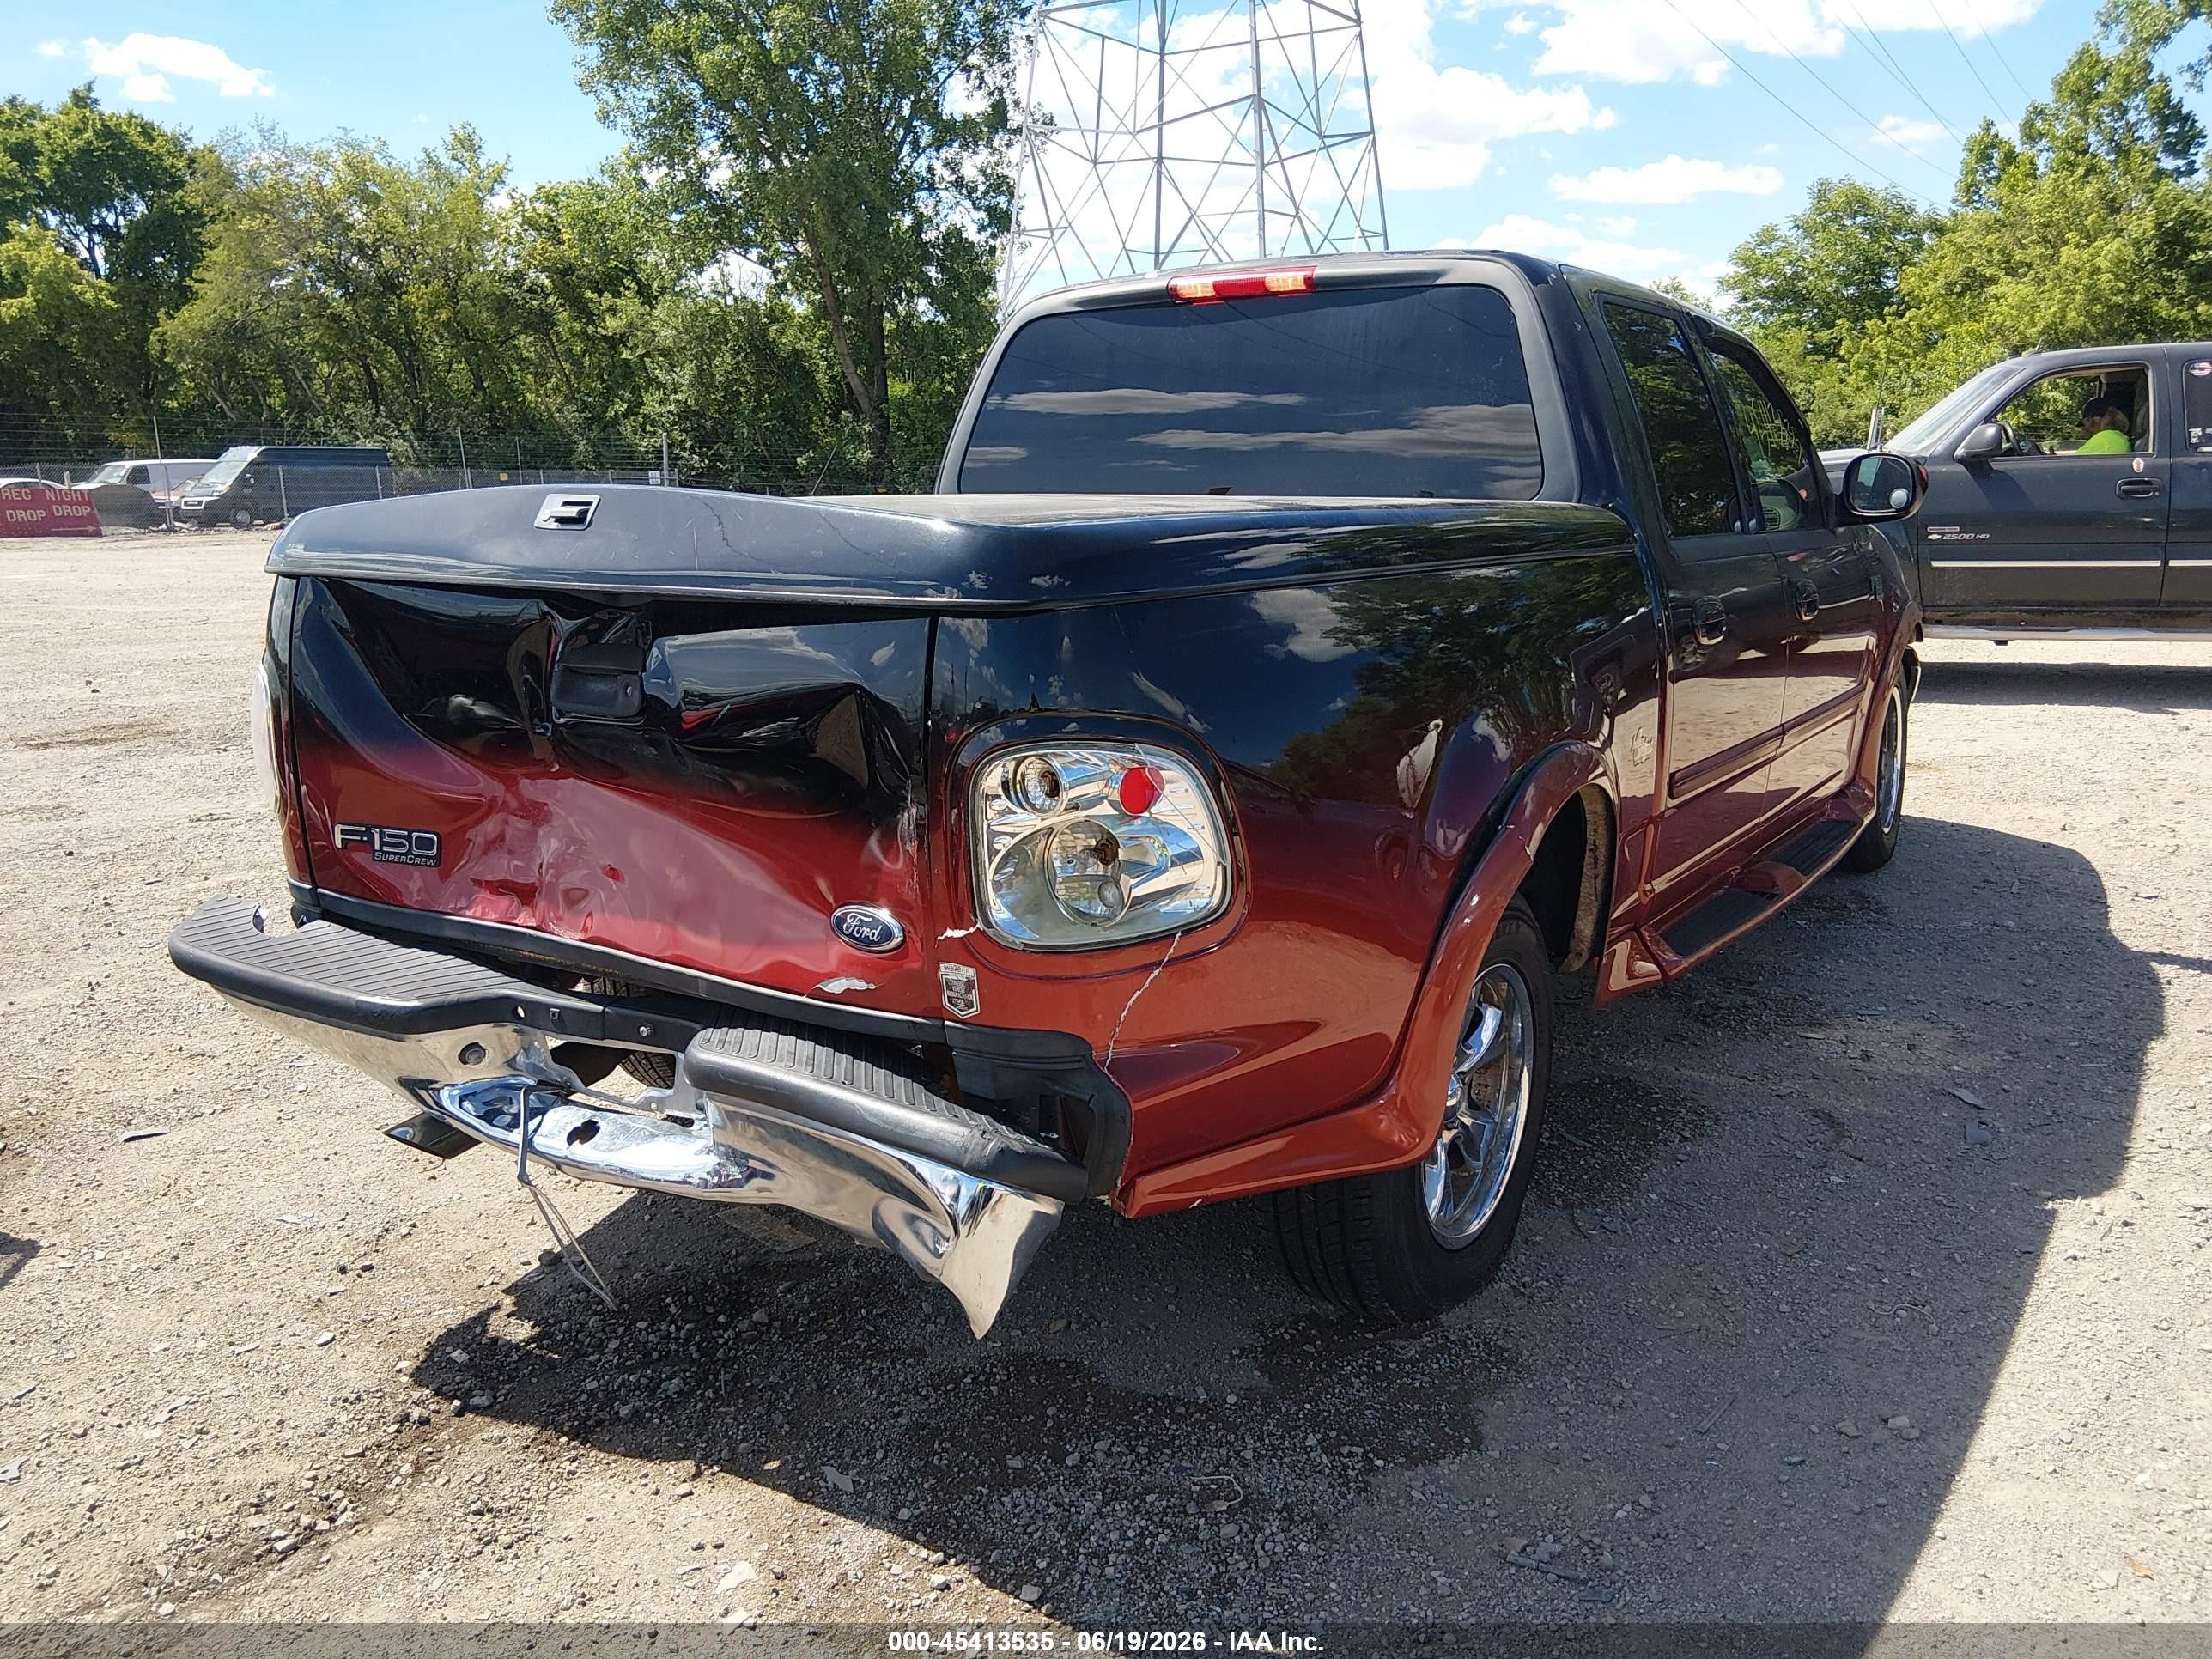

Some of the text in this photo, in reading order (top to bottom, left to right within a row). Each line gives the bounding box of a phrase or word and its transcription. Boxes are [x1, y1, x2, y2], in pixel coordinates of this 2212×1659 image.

[45, 489, 89, 501] NIGHT
[6, 509, 46, 522] DROP
[52, 505, 91, 517] DROP
[842, 912, 883, 942] Ford
